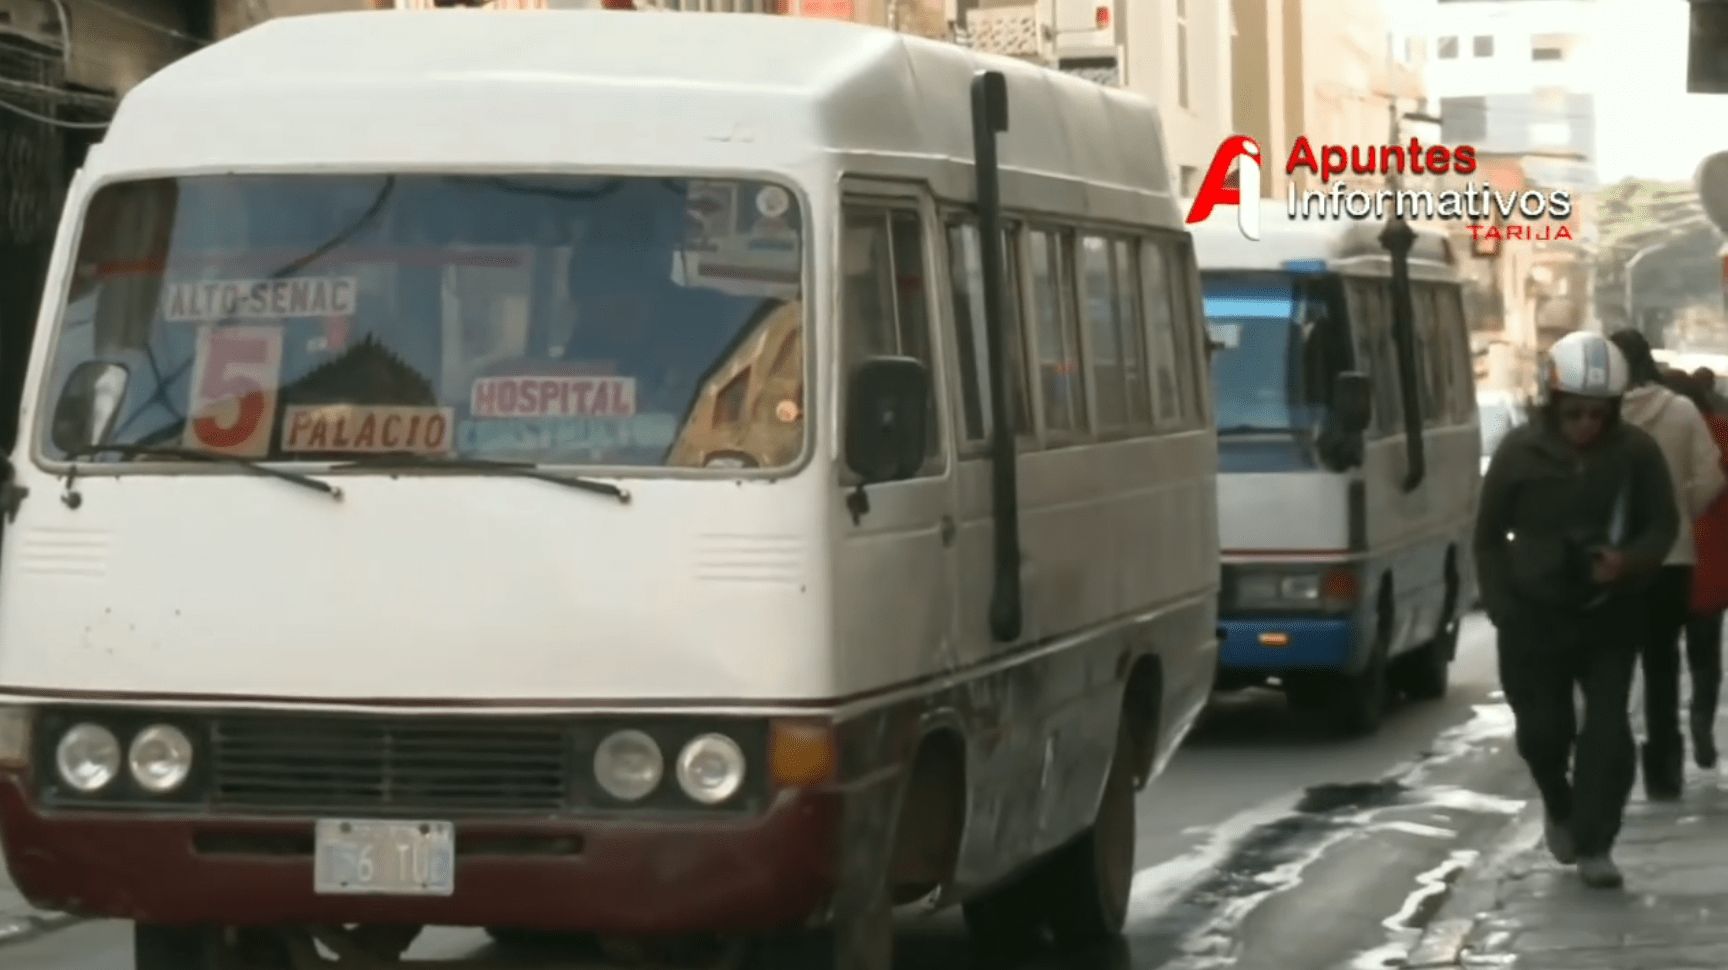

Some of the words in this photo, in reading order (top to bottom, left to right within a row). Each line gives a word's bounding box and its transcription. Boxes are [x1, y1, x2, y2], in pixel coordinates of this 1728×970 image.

[193, 337, 268, 448] 5
[476, 380, 631, 416] HOSPITAL
[288, 413, 446, 448] PALACIO
